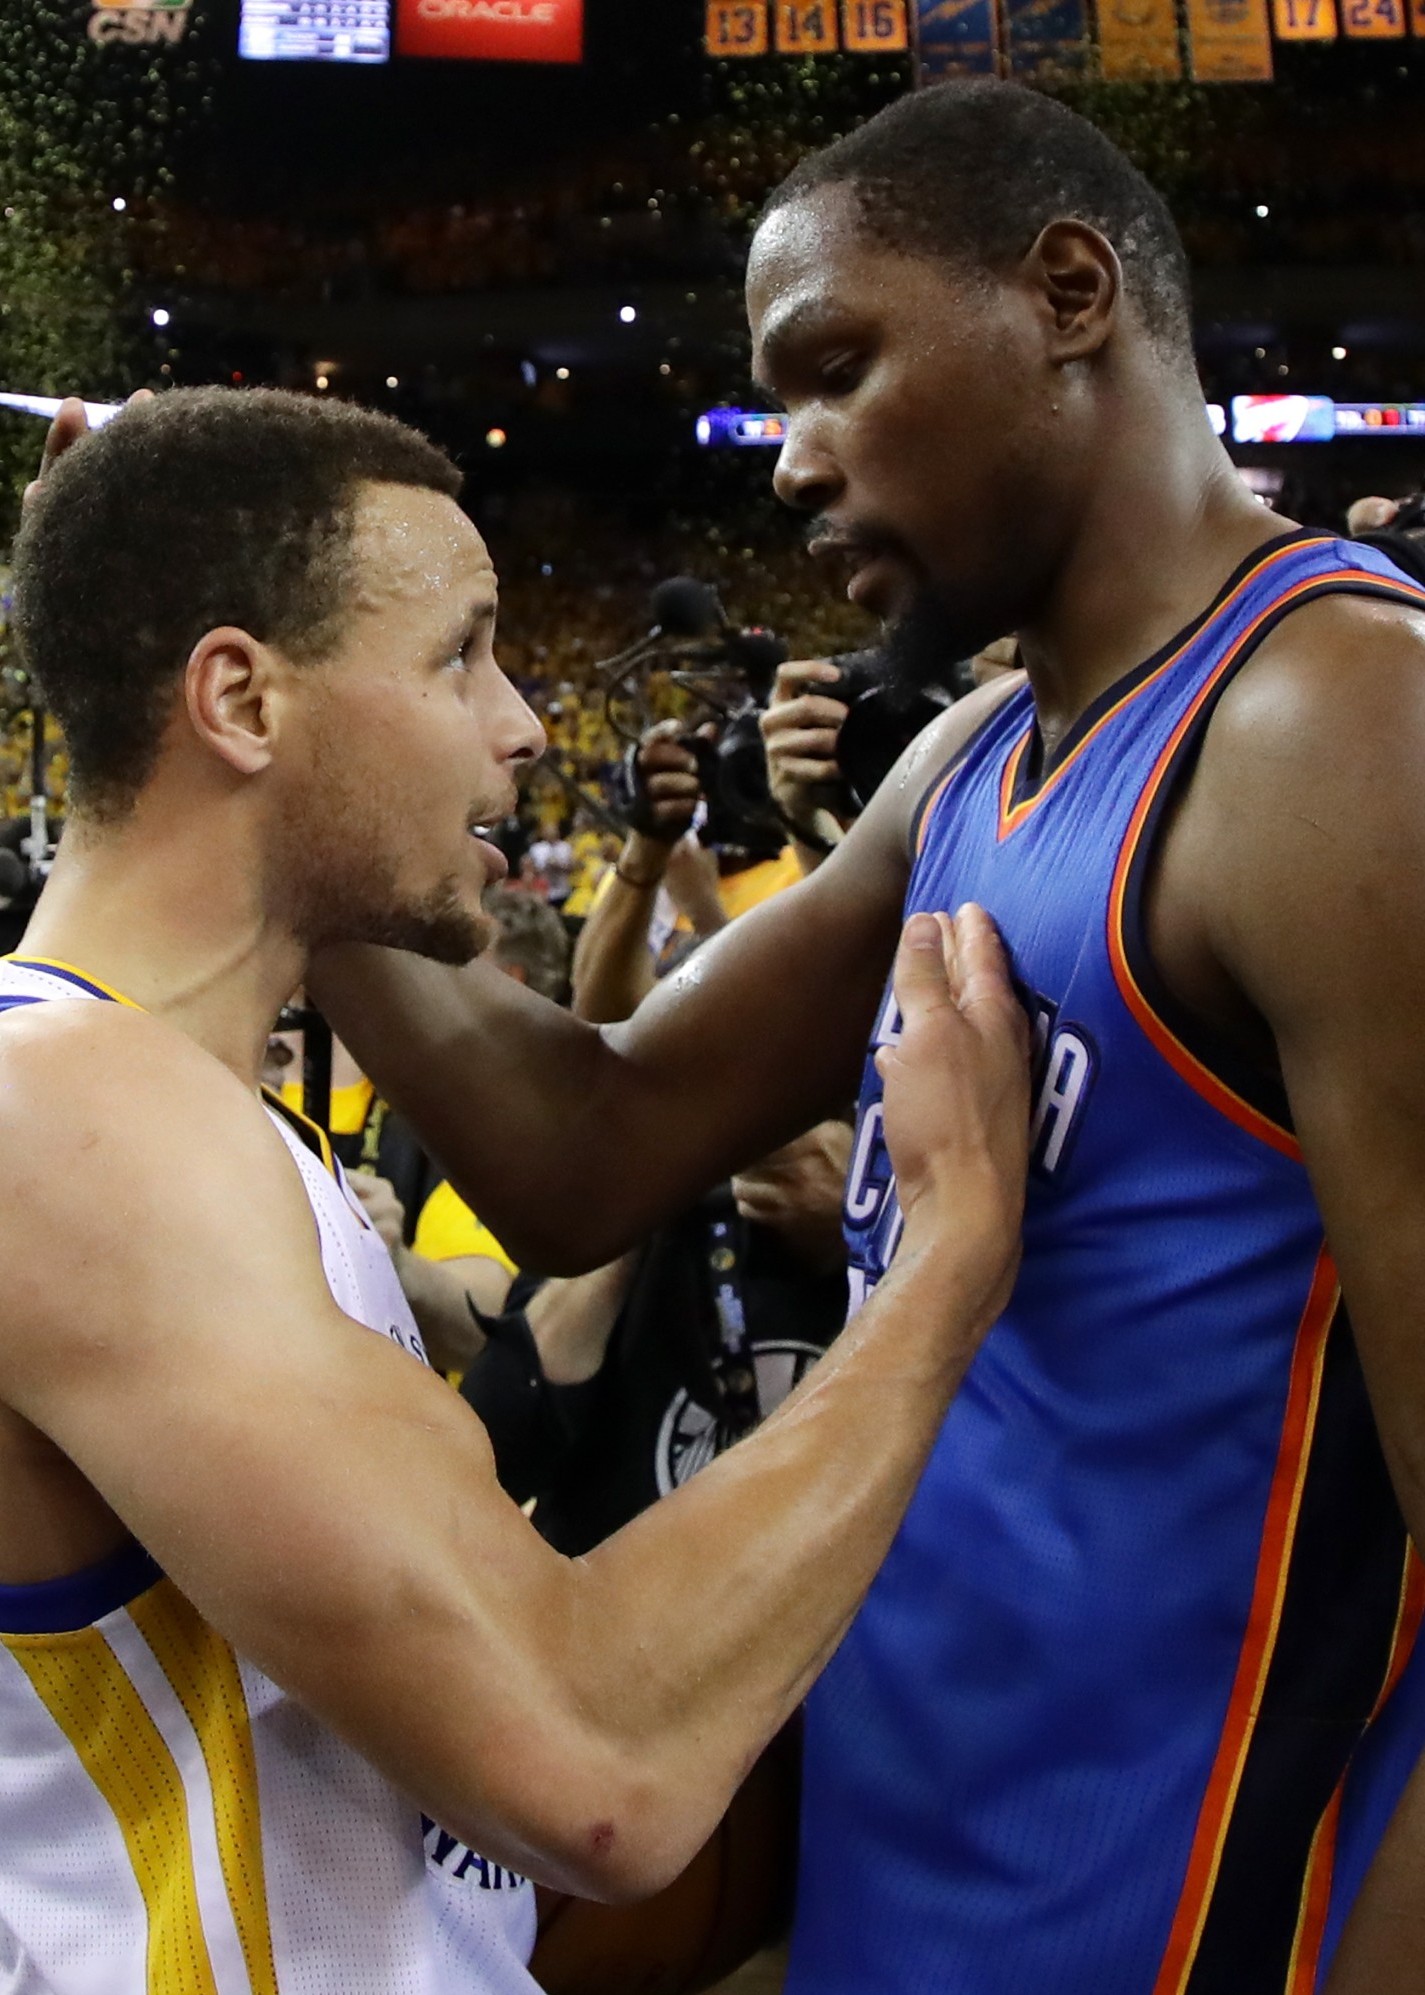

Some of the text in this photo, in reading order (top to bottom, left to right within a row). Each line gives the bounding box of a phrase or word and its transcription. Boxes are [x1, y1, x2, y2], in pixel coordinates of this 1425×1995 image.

[87, 8, 188, 44] CSN
[417, 0, 558, 25] ORACLE
[718, 8, 756, 43] 13
[787, 4, 824, 40] 14
[857, 1, 893, 38] 16
[1285, 0, 1319, 27] 17
[1351, 0, 1397, 26] 24
